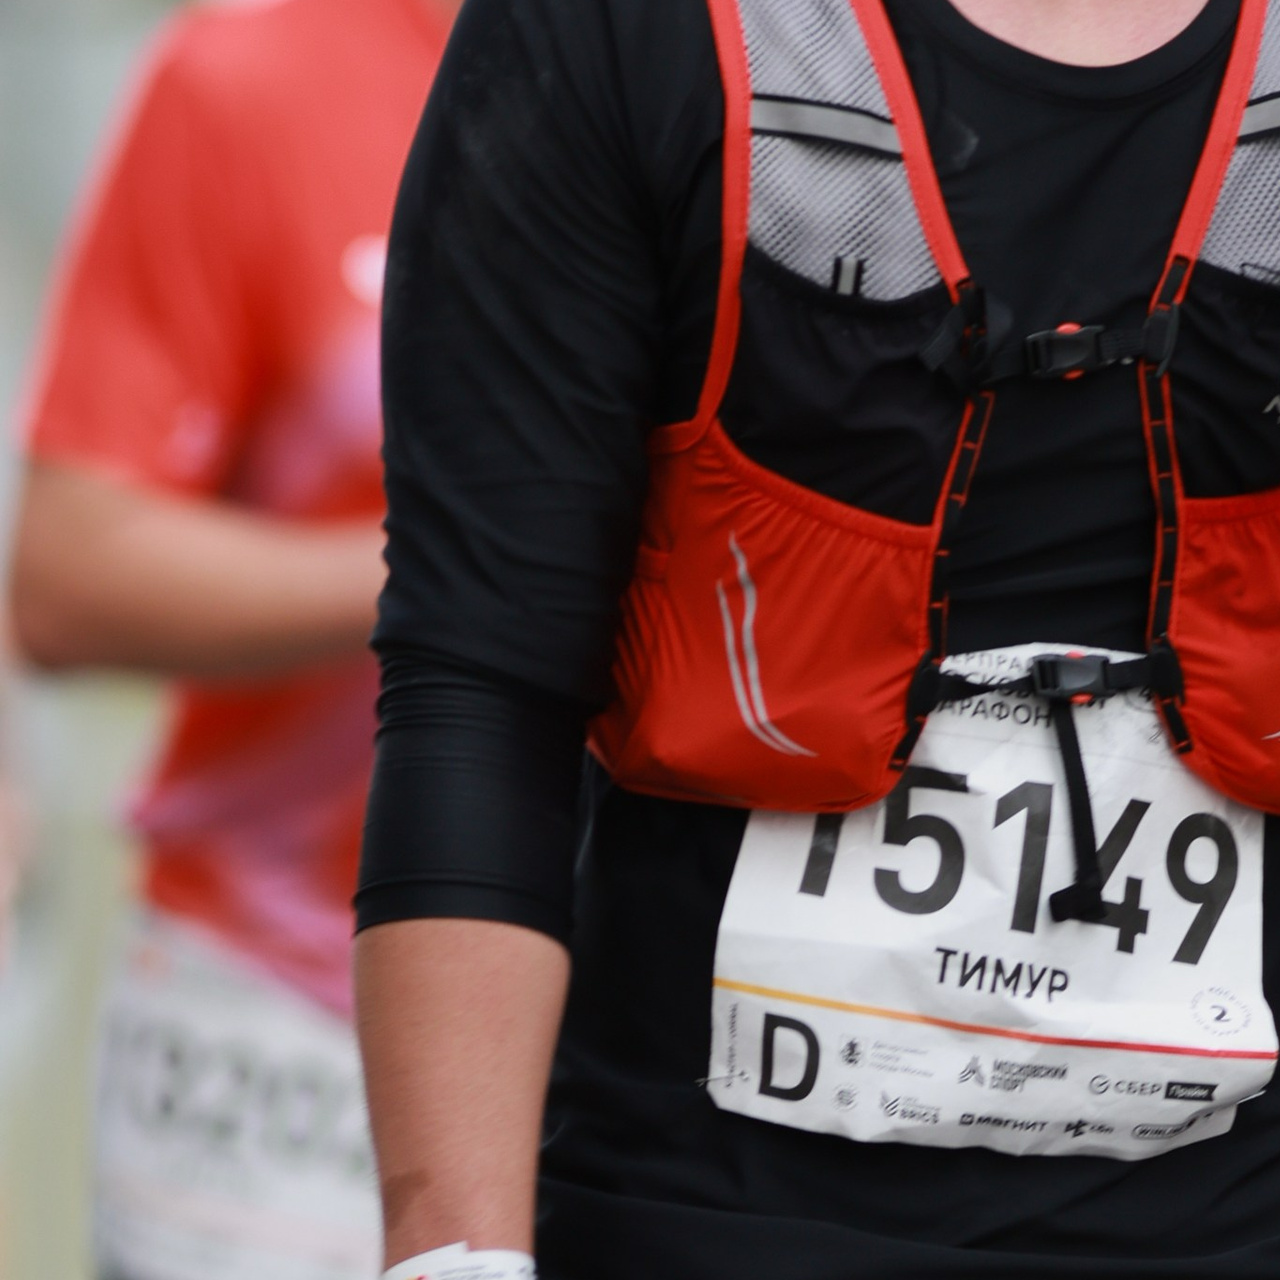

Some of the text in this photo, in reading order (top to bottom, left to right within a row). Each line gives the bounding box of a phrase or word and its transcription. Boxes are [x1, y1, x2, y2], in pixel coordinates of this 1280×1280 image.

[937, 697, 1052, 728] АРАФОН
[934, 946, 1070, 1002] ТИМУР
[758, 1012, 820, 1102] D
[1114, 1080, 1162, 1097] СБЕР
